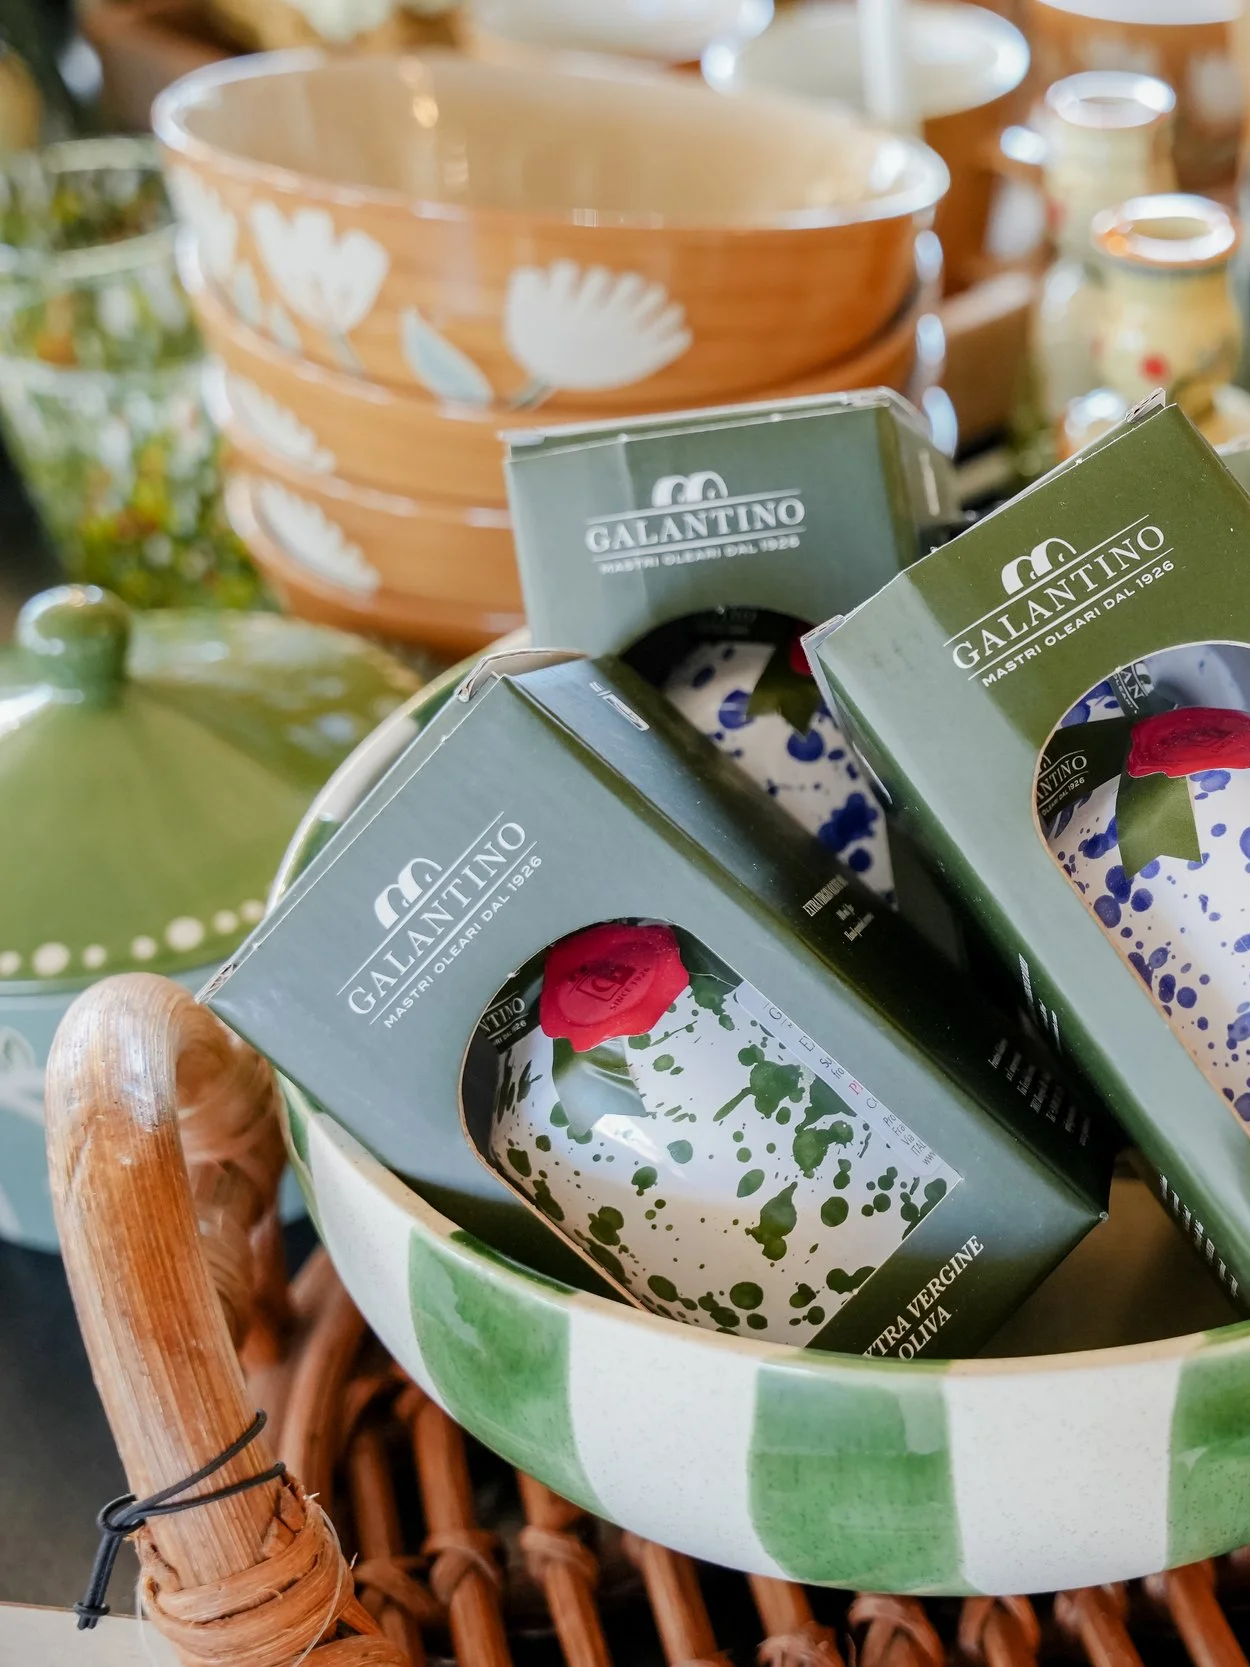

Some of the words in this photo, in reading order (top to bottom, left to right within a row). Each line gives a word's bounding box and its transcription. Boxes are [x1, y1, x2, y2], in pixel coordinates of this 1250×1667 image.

[584, 498, 805, 553] GALANTINO
[599, 555, 660, 574] MASTRI
[661, 548, 722, 566] OLEARI
[723, 542, 758, 559] DAL
[952, 525, 1164, 669] GALANTINO
[982, 644, 1042, 687] MASTRI
[1044, 607, 1101, 646] OLEARI
[1103, 587, 1136, 610] DAL
[1135, 560, 1175, 588] 1926
[1068, 777, 1085, 791] 1926
[348, 822, 526, 1014] GALANTINO
[384, 976, 434, 1028] MASTRI
[434, 923, 482, 973] OLEARI
[482, 893, 511, 922] DAL
[507, 856, 542, 892] 1926
[862, 1315, 911, 1358] XTRA
[906, 1235, 984, 1318] VERGINE
[898, 1305, 952, 1361] OLIVA
